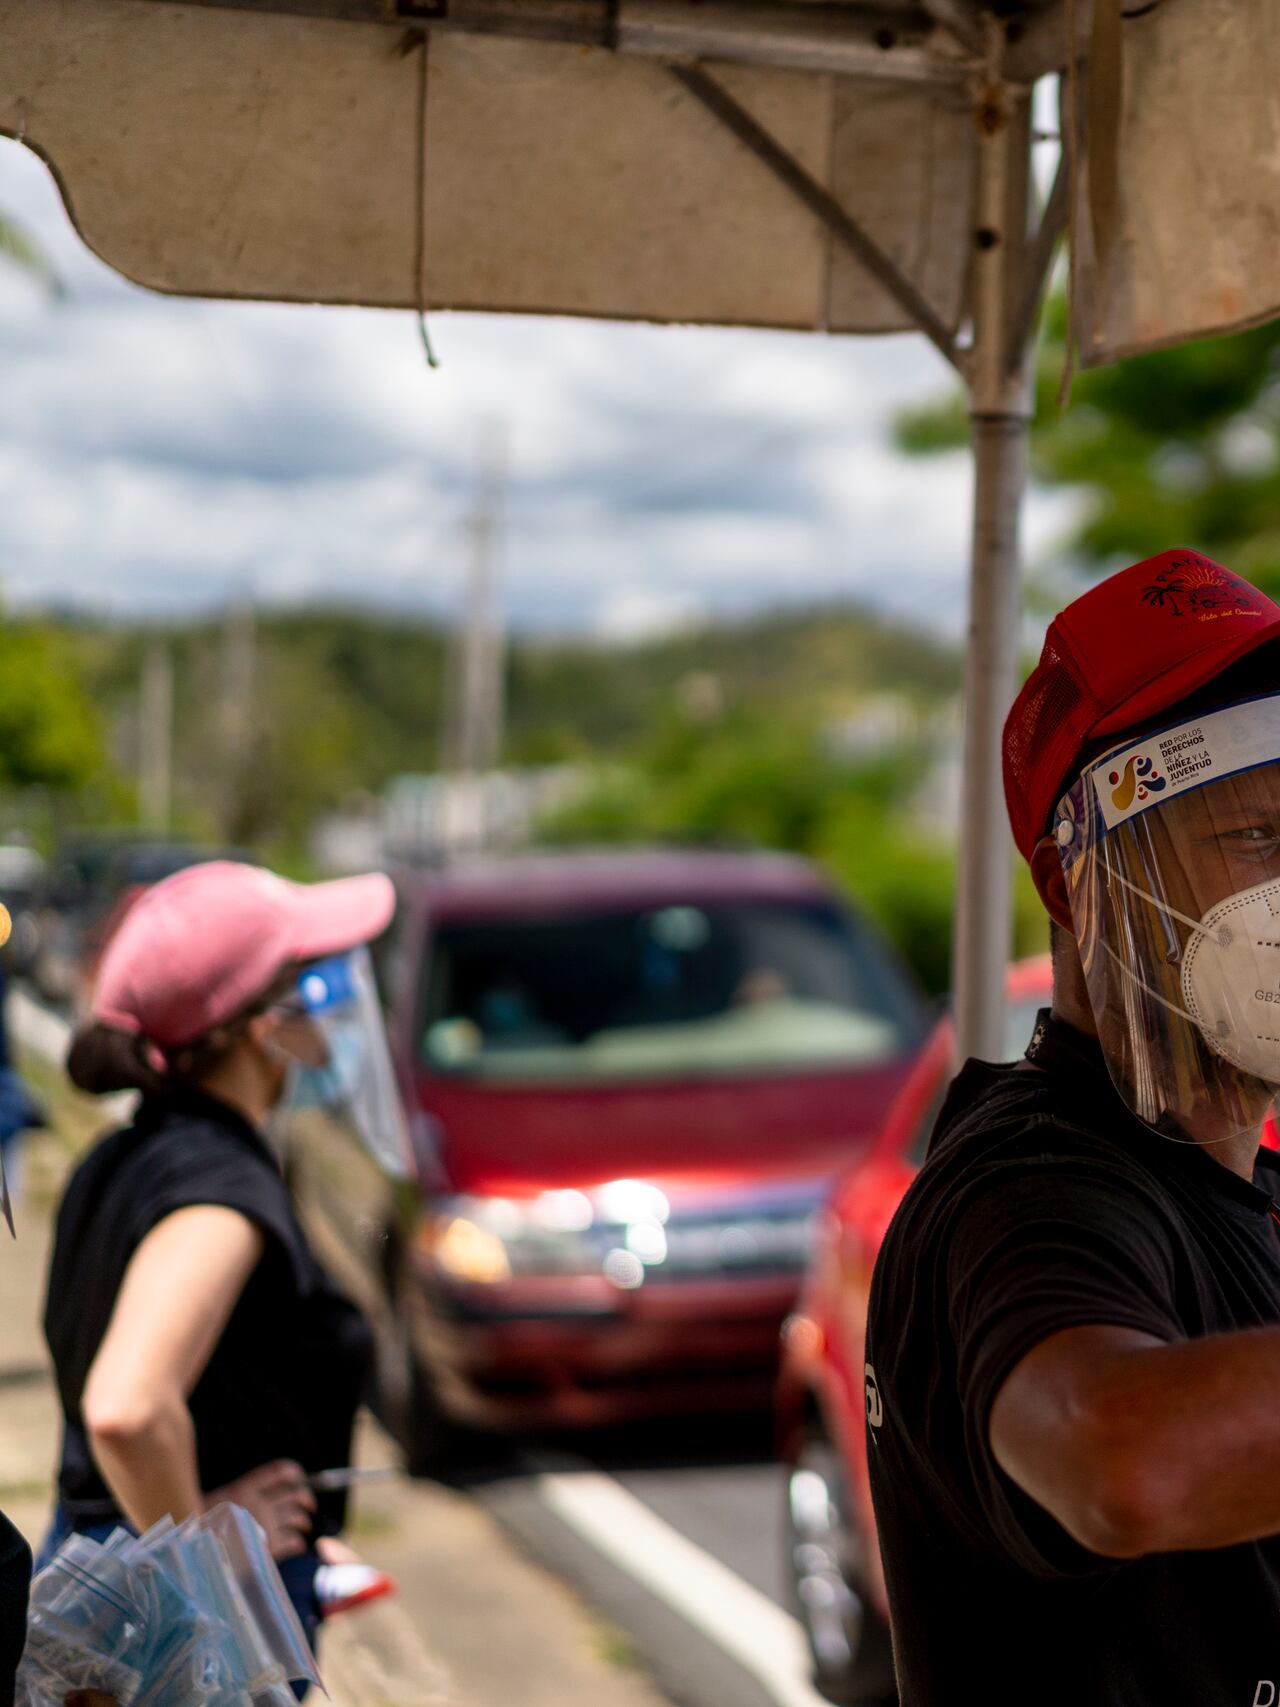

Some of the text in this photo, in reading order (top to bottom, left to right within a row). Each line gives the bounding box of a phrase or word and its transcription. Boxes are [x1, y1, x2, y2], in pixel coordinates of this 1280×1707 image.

[1159, 728, 1201, 749] RED POR LOS
[1162, 735, 1204, 757] DERECHOS
[1164, 756, 1174, 765] DE
[1199, 750, 1209, 759] LA
[1170, 759, 1211, 781] JUVENTUD
